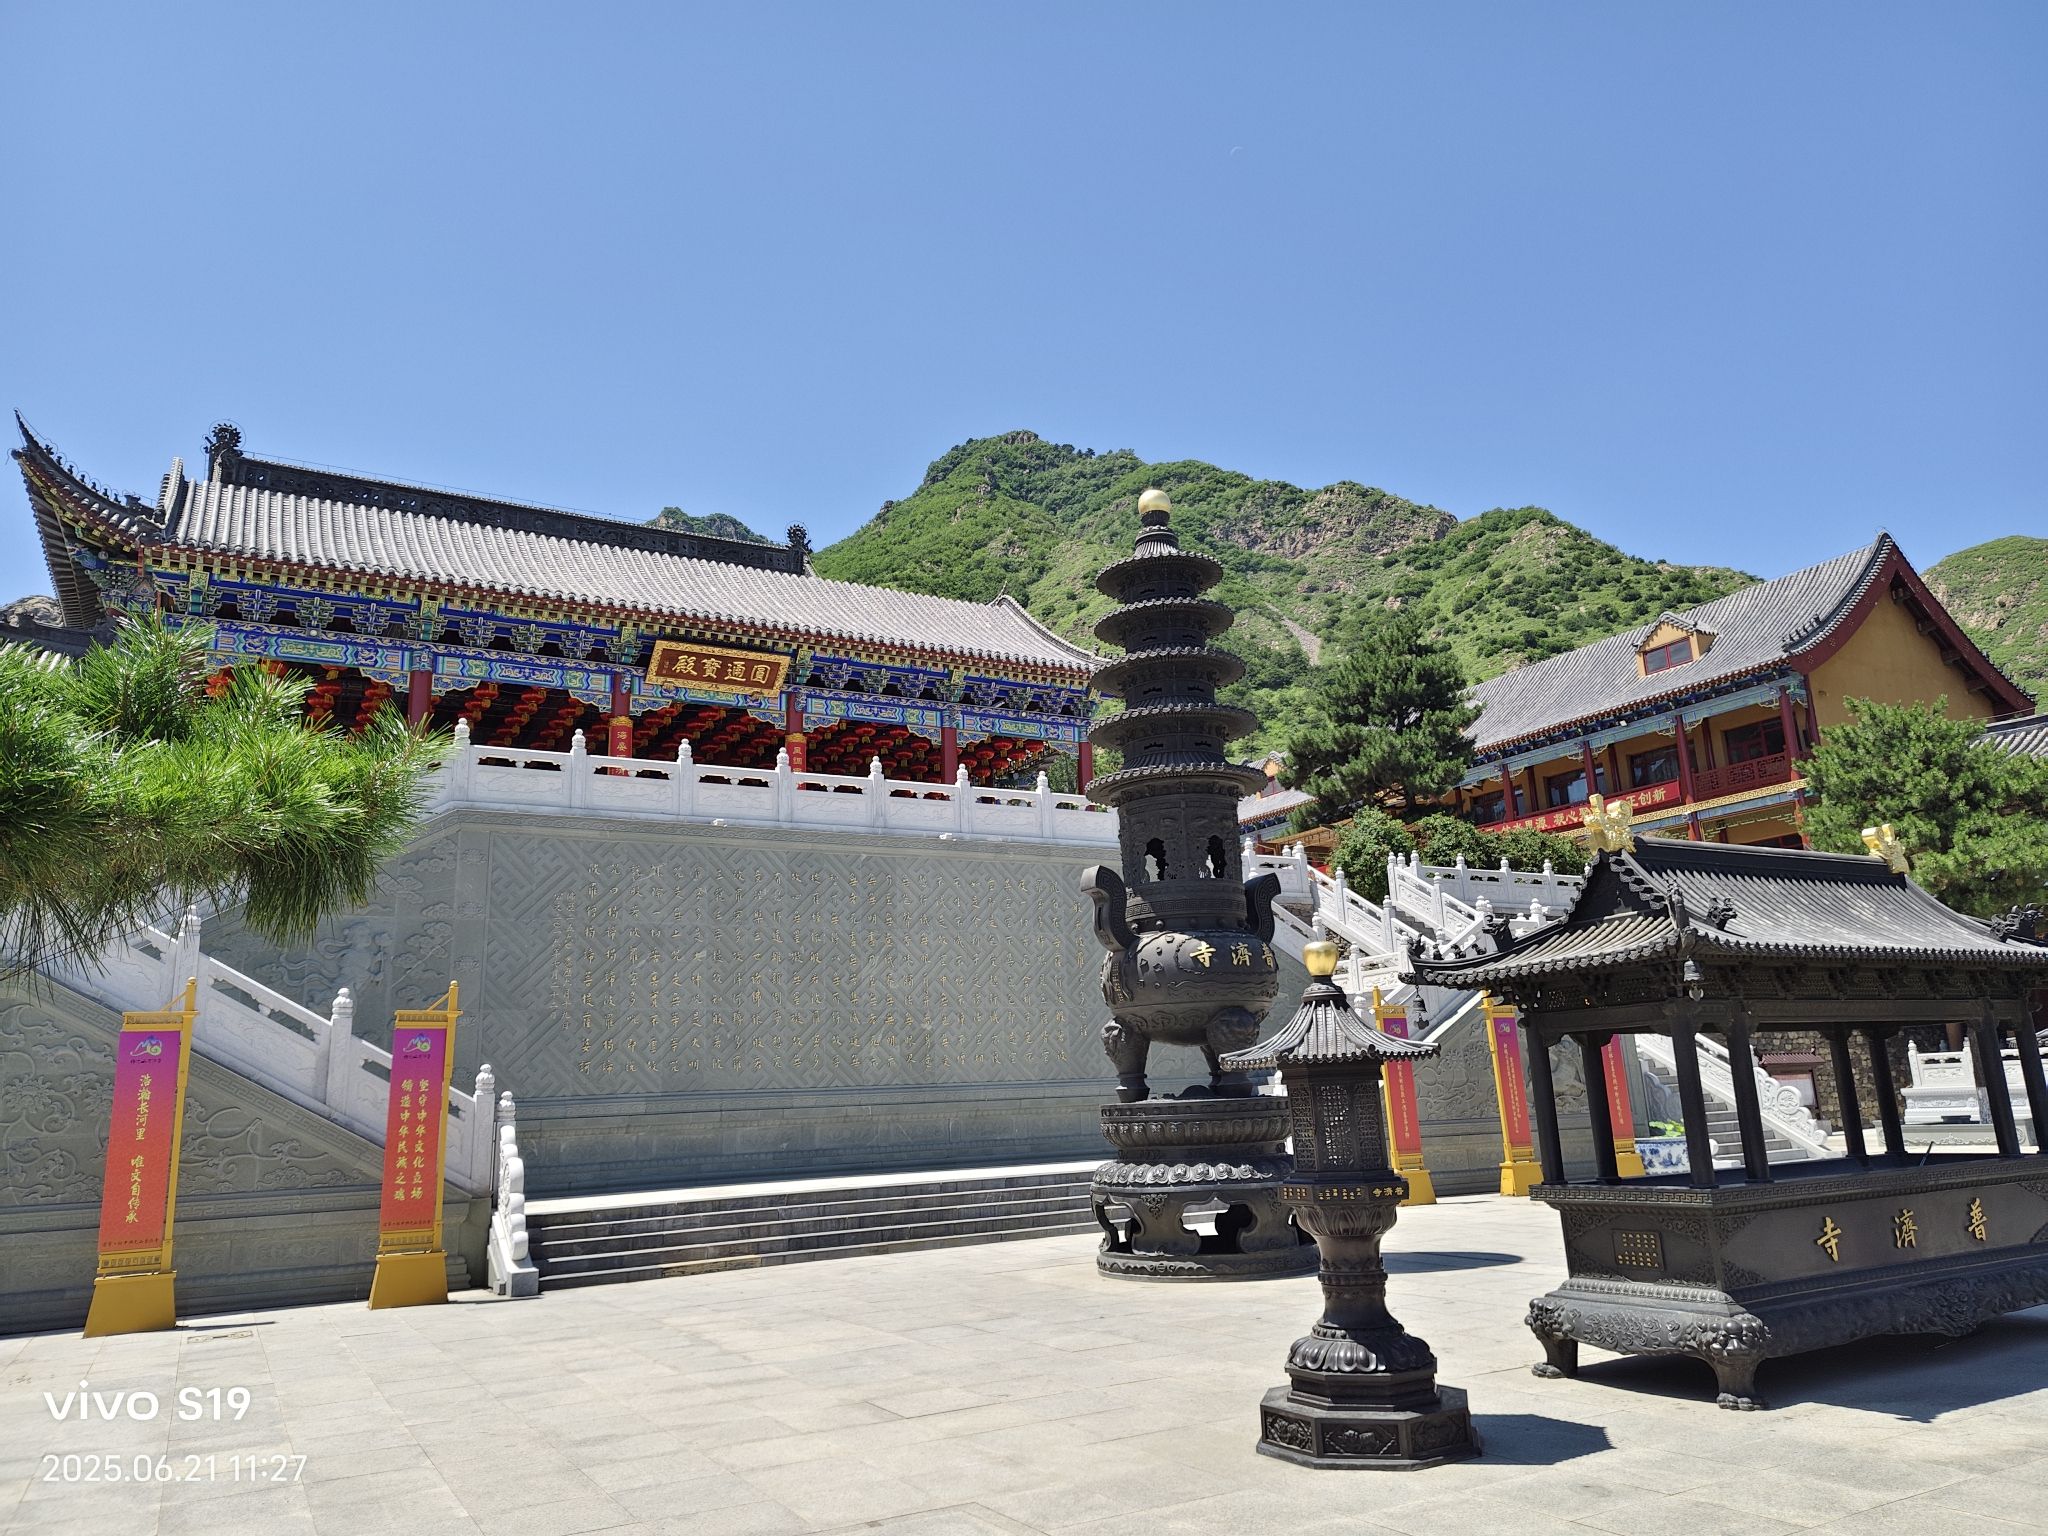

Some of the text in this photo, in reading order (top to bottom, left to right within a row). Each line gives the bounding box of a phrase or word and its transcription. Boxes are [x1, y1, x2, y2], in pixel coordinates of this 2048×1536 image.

[672, 655, 771, 684] 圓通寶殿
[1189, 941, 1274, 968] 普濟寺
[135, 1073, 152, 1141] 浩瀚长河里
[1816, 1197, 1990, 1262] 普濟寺
